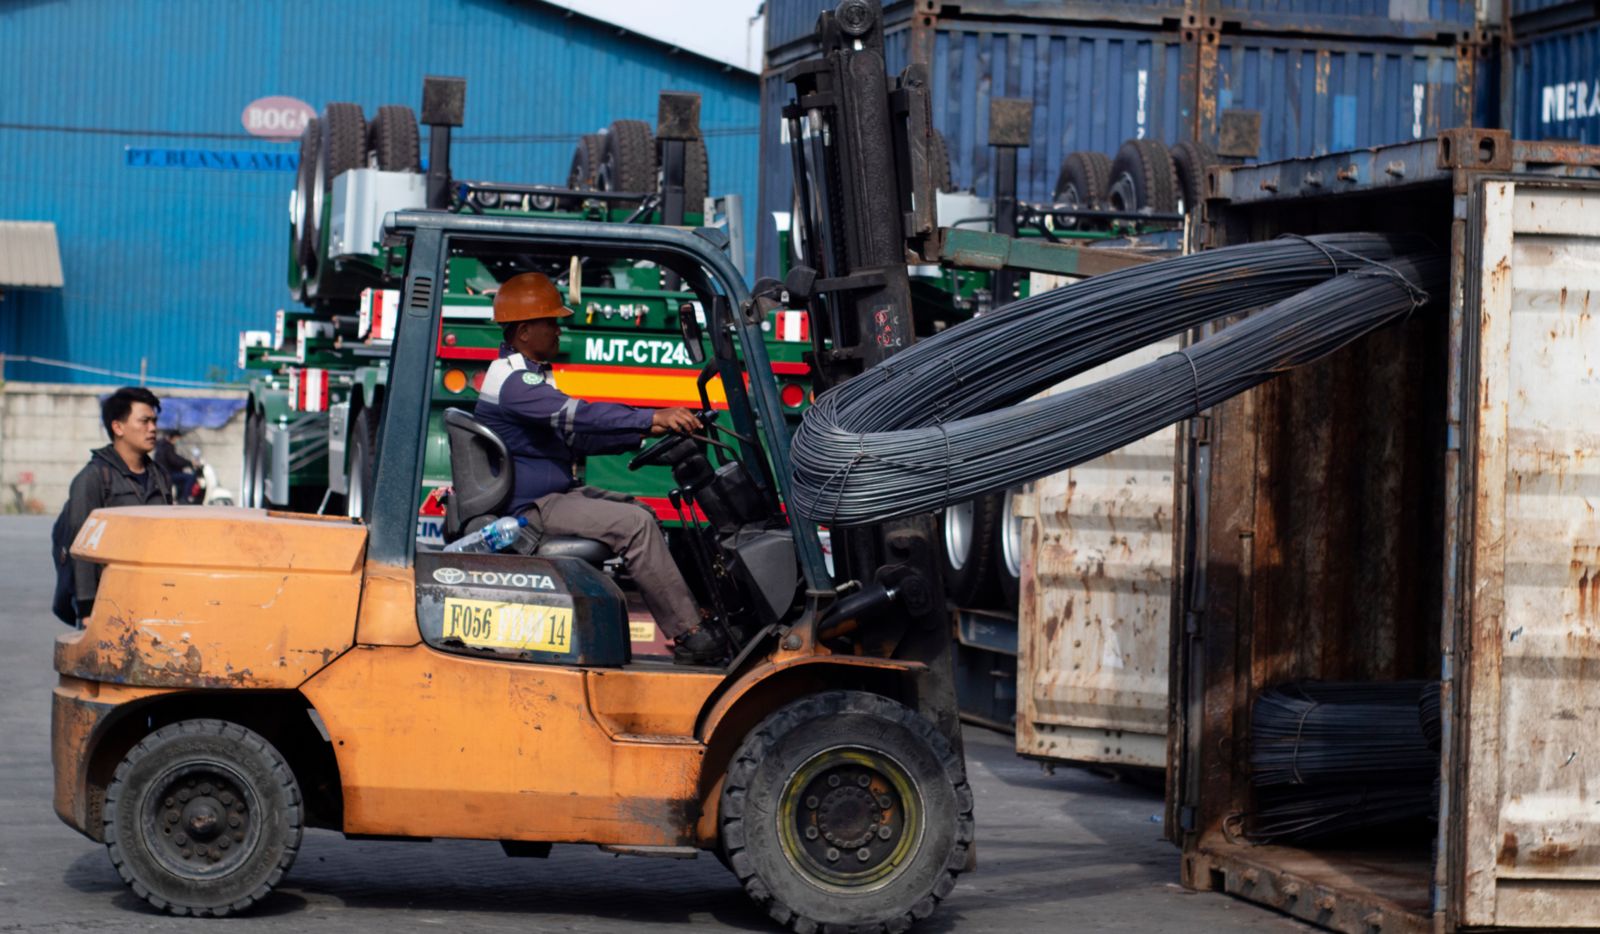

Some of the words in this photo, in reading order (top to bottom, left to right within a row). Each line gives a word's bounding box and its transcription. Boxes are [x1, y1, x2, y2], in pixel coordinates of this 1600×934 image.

[468, 570, 556, 590] TOYOTA
[450, 604, 492, 640] F056
[548, 614, 566, 646] 14
